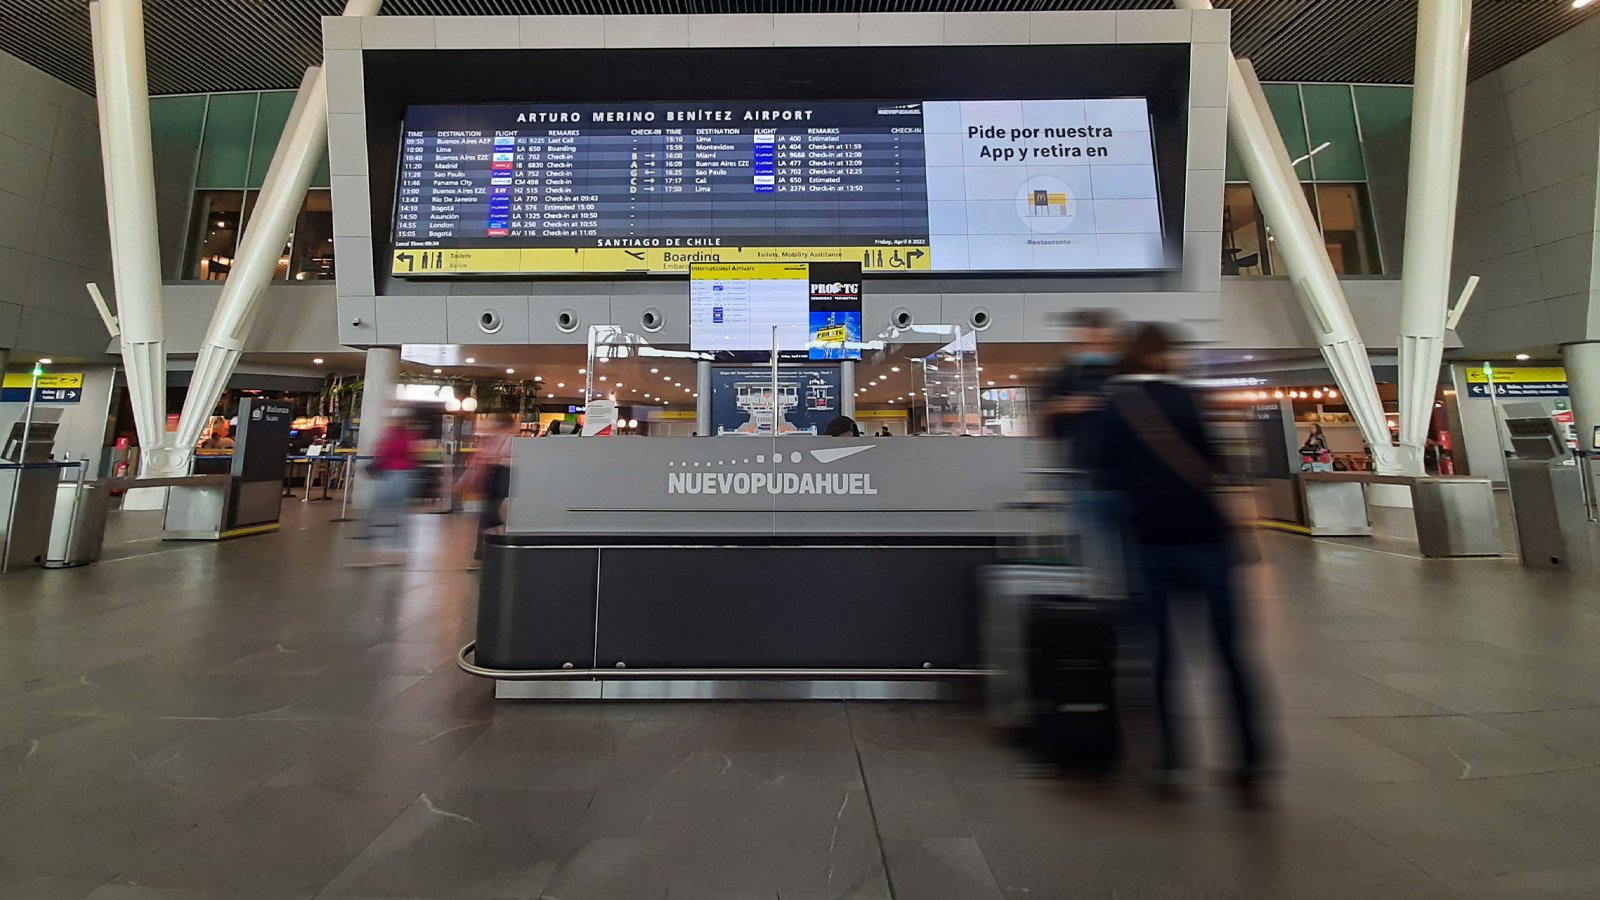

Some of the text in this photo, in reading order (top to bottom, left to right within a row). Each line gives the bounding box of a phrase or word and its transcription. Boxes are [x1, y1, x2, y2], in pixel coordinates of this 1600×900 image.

[517, 109, 813, 122] ARTURO MERINO BENÍTEZ AIRPORT
[968, 125, 1112, 141] Pide por nuestra
[980, 144, 1108, 161] App y retira en
[597, 238, 721, 246] SANTIAGO DE CHILE
[664, 252, 719, 262] Boarding
[811, 284, 858, 293] PRO TG
[668, 472, 877, 495] NUEVOPUDAHUEL
